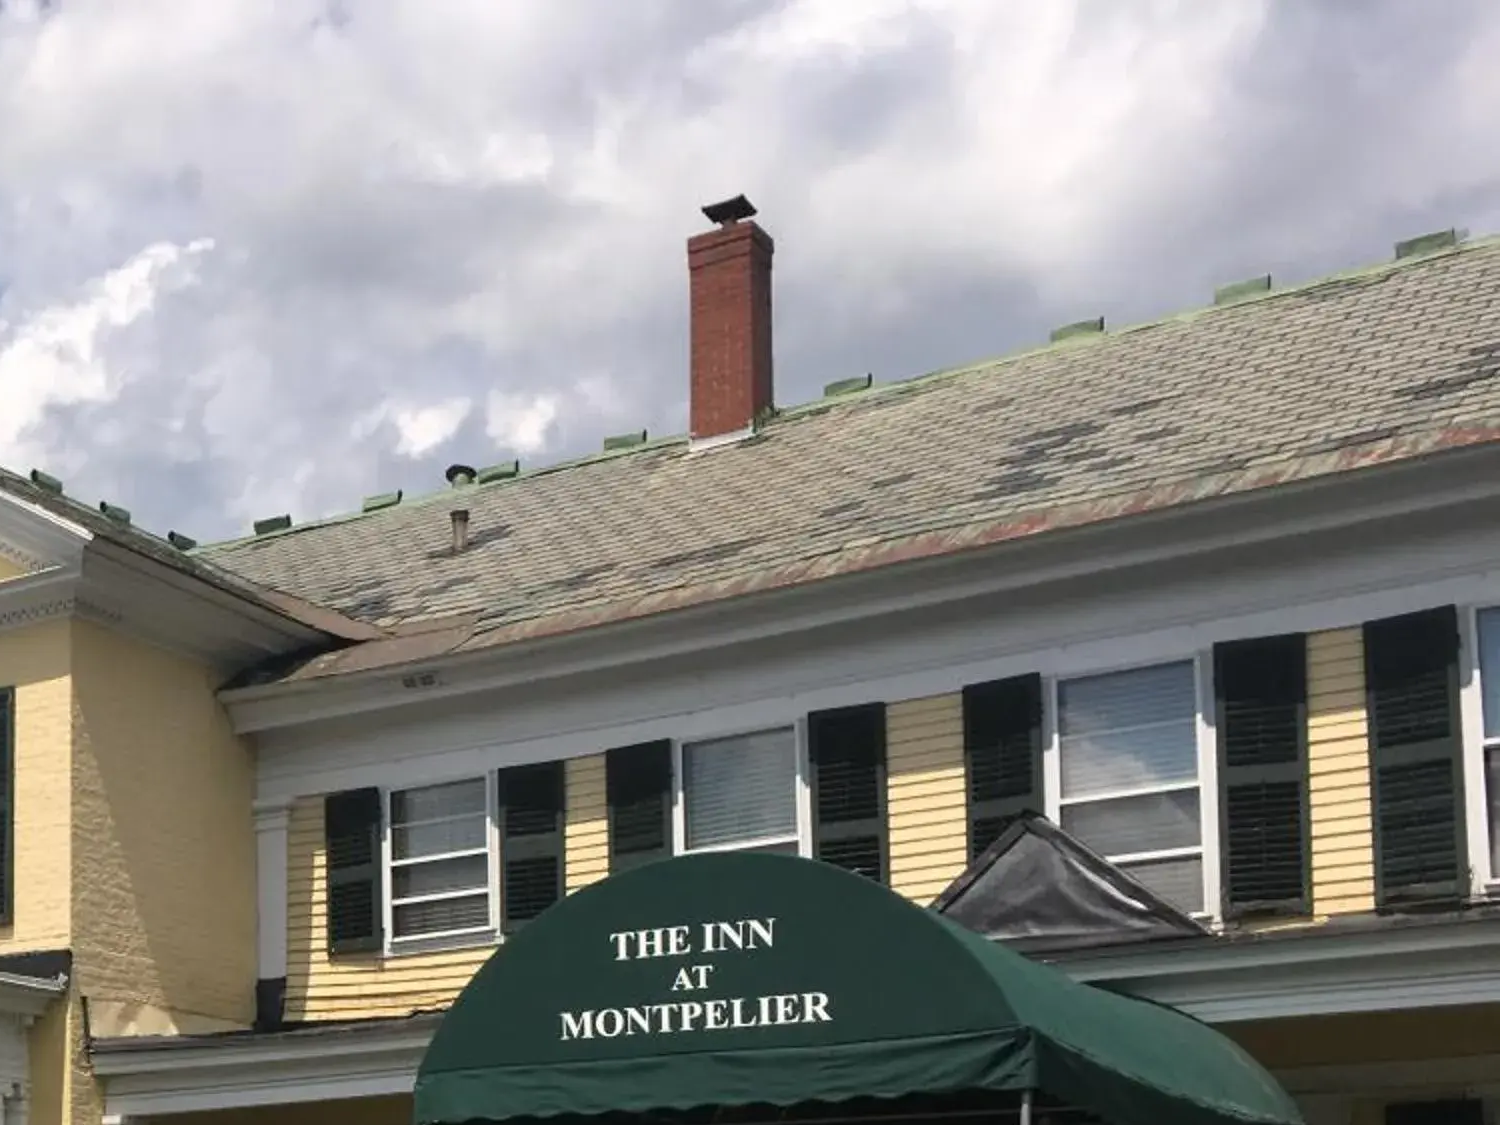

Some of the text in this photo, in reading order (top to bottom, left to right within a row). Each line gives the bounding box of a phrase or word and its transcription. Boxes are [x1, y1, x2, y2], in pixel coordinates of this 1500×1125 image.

[609, 917, 776, 961] THE INN
[671, 965, 713, 992] AT
[559, 991, 832, 1041] MONTPELIER
